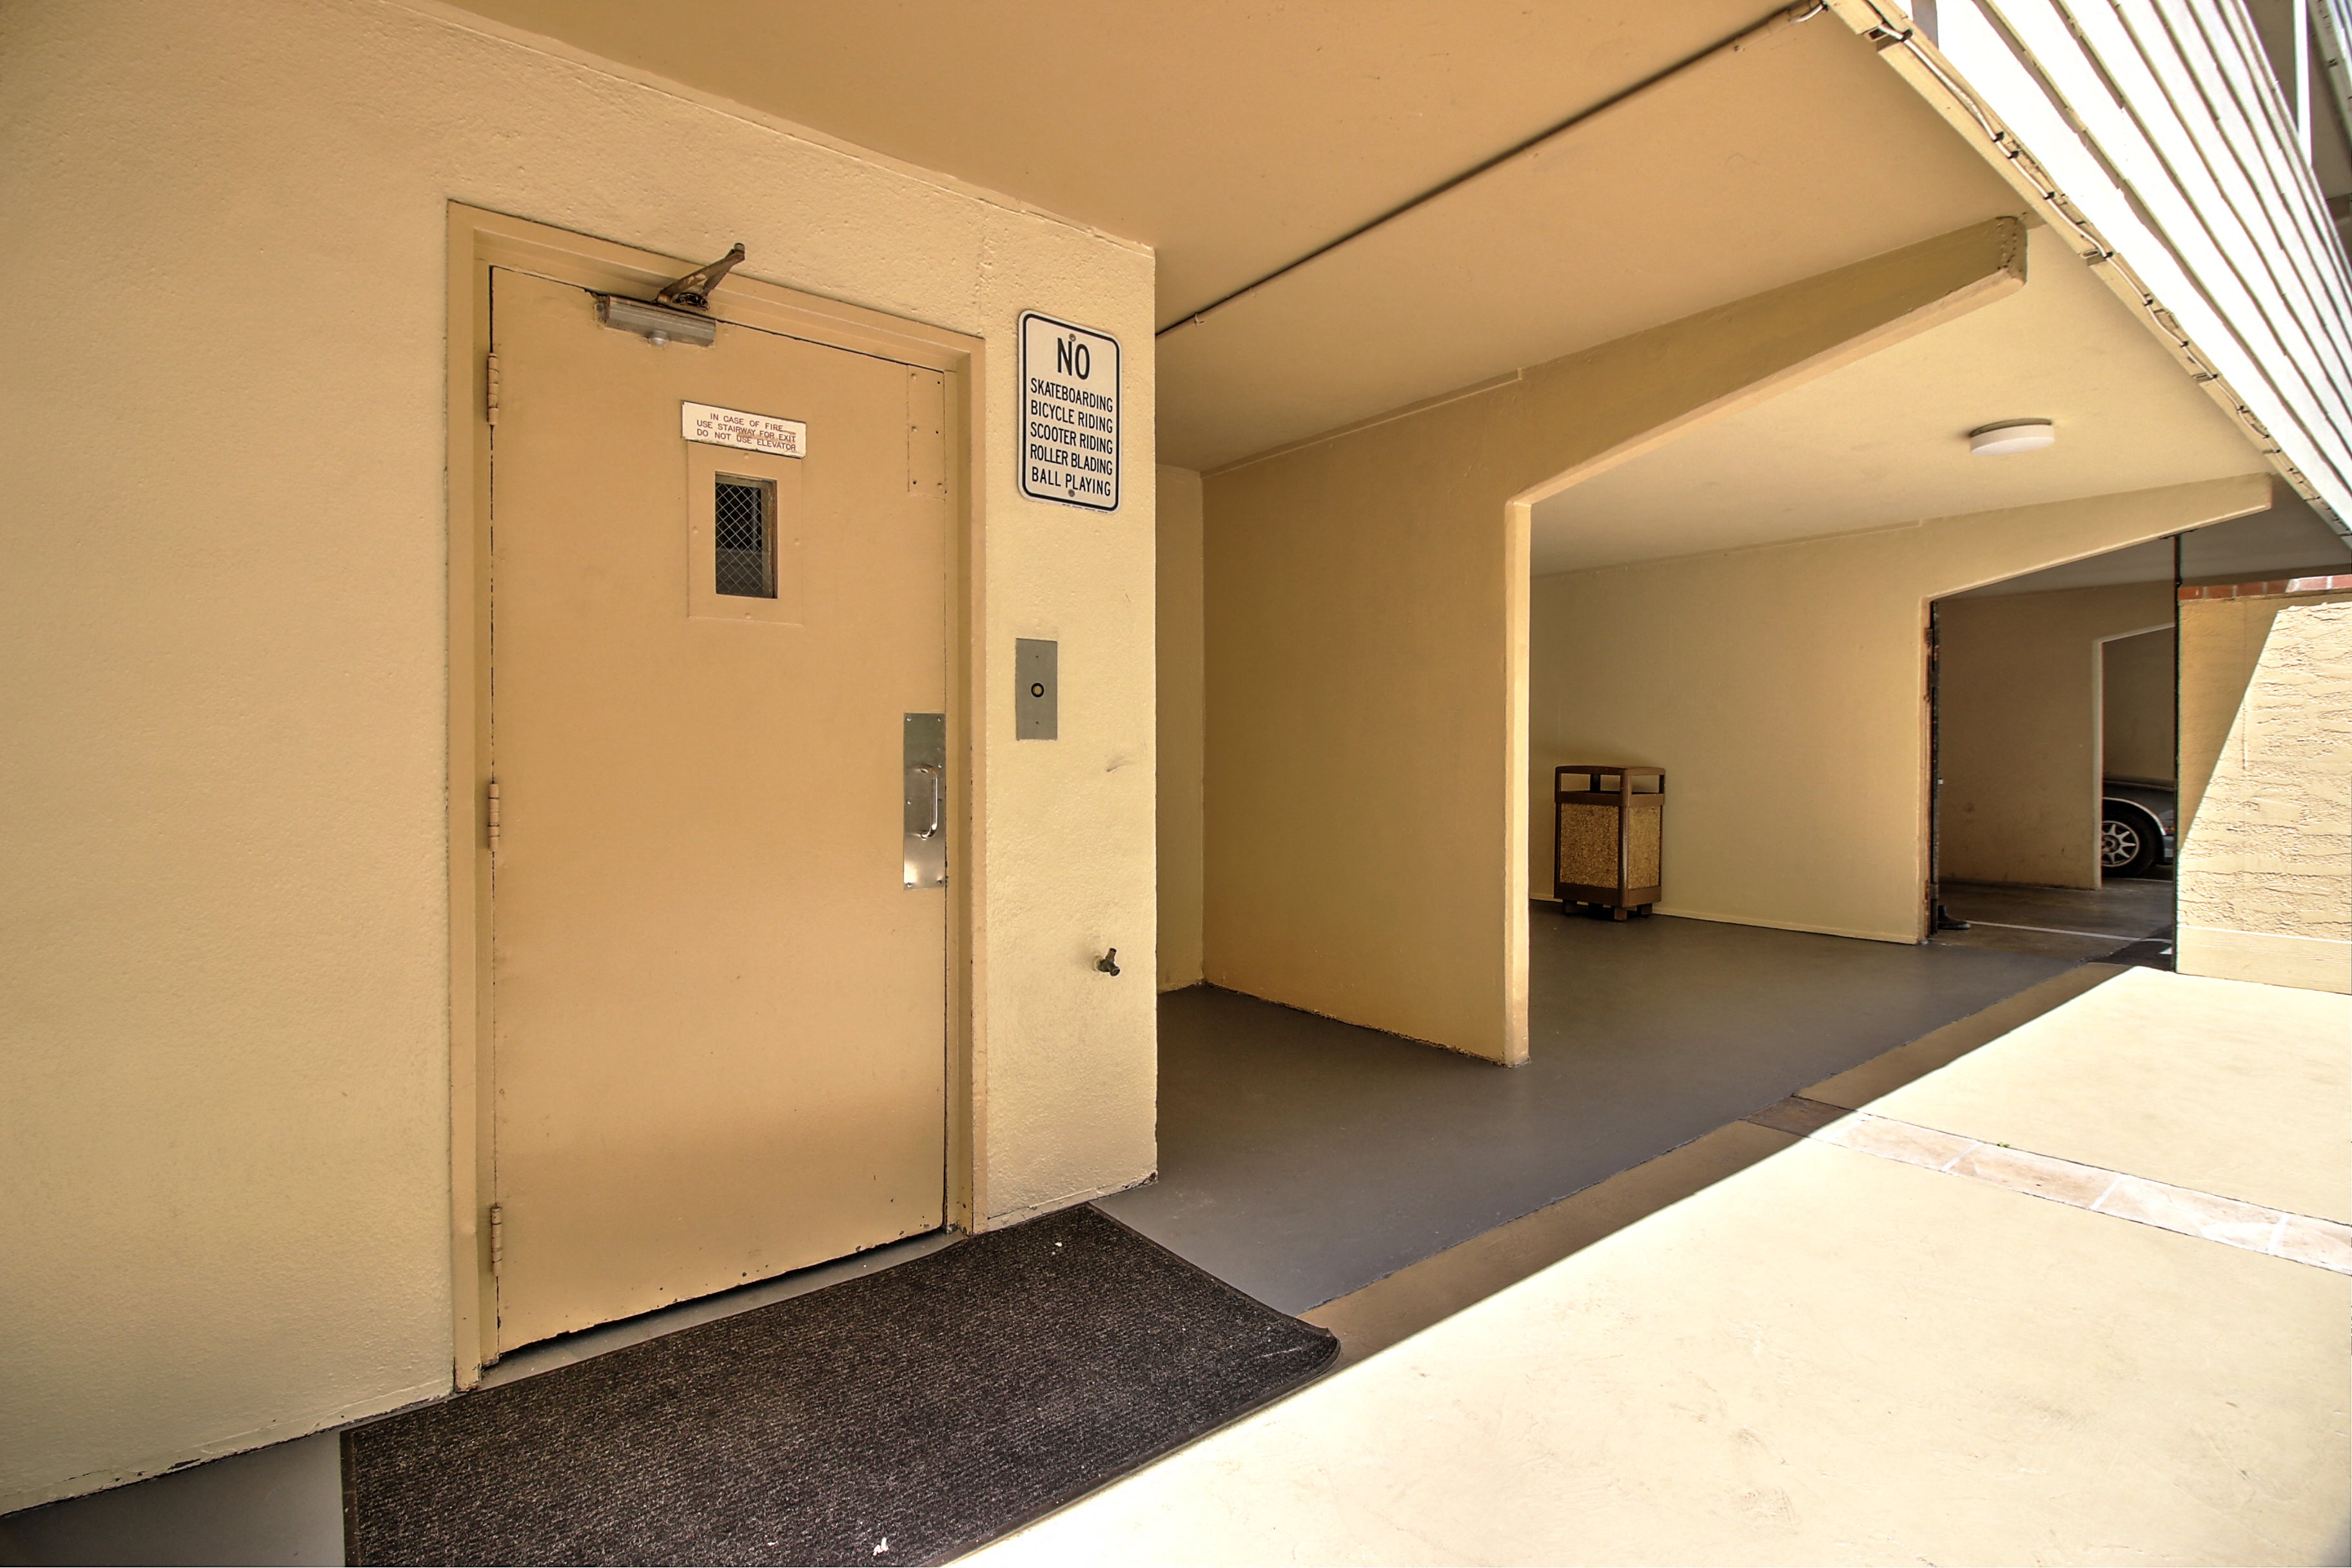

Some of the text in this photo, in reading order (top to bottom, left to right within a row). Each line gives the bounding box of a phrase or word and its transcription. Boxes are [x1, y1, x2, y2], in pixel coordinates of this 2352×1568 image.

[1057, 337, 1090, 380] NO
[1031, 378, 1113, 413] SKATEBOARDING
[697, 420, 796, 442] USE STAIRWAY FOR EXIT
[723, 415, 744, 426] CASE
[765, 423, 783, 432] FIRE
[1031, 400, 1113, 433] BICYCLE RIDING
[714, 432, 731, 440] NOT
[736, 435, 752, 444] USE
[757, 438, 796, 451] ELEVATOR
[1030, 422, 1113, 455] SCOOTER RIDING
[1030, 444, 1113, 475] ROLLER BLADING
[1032, 466, 1110, 496] BALL PLAYING
